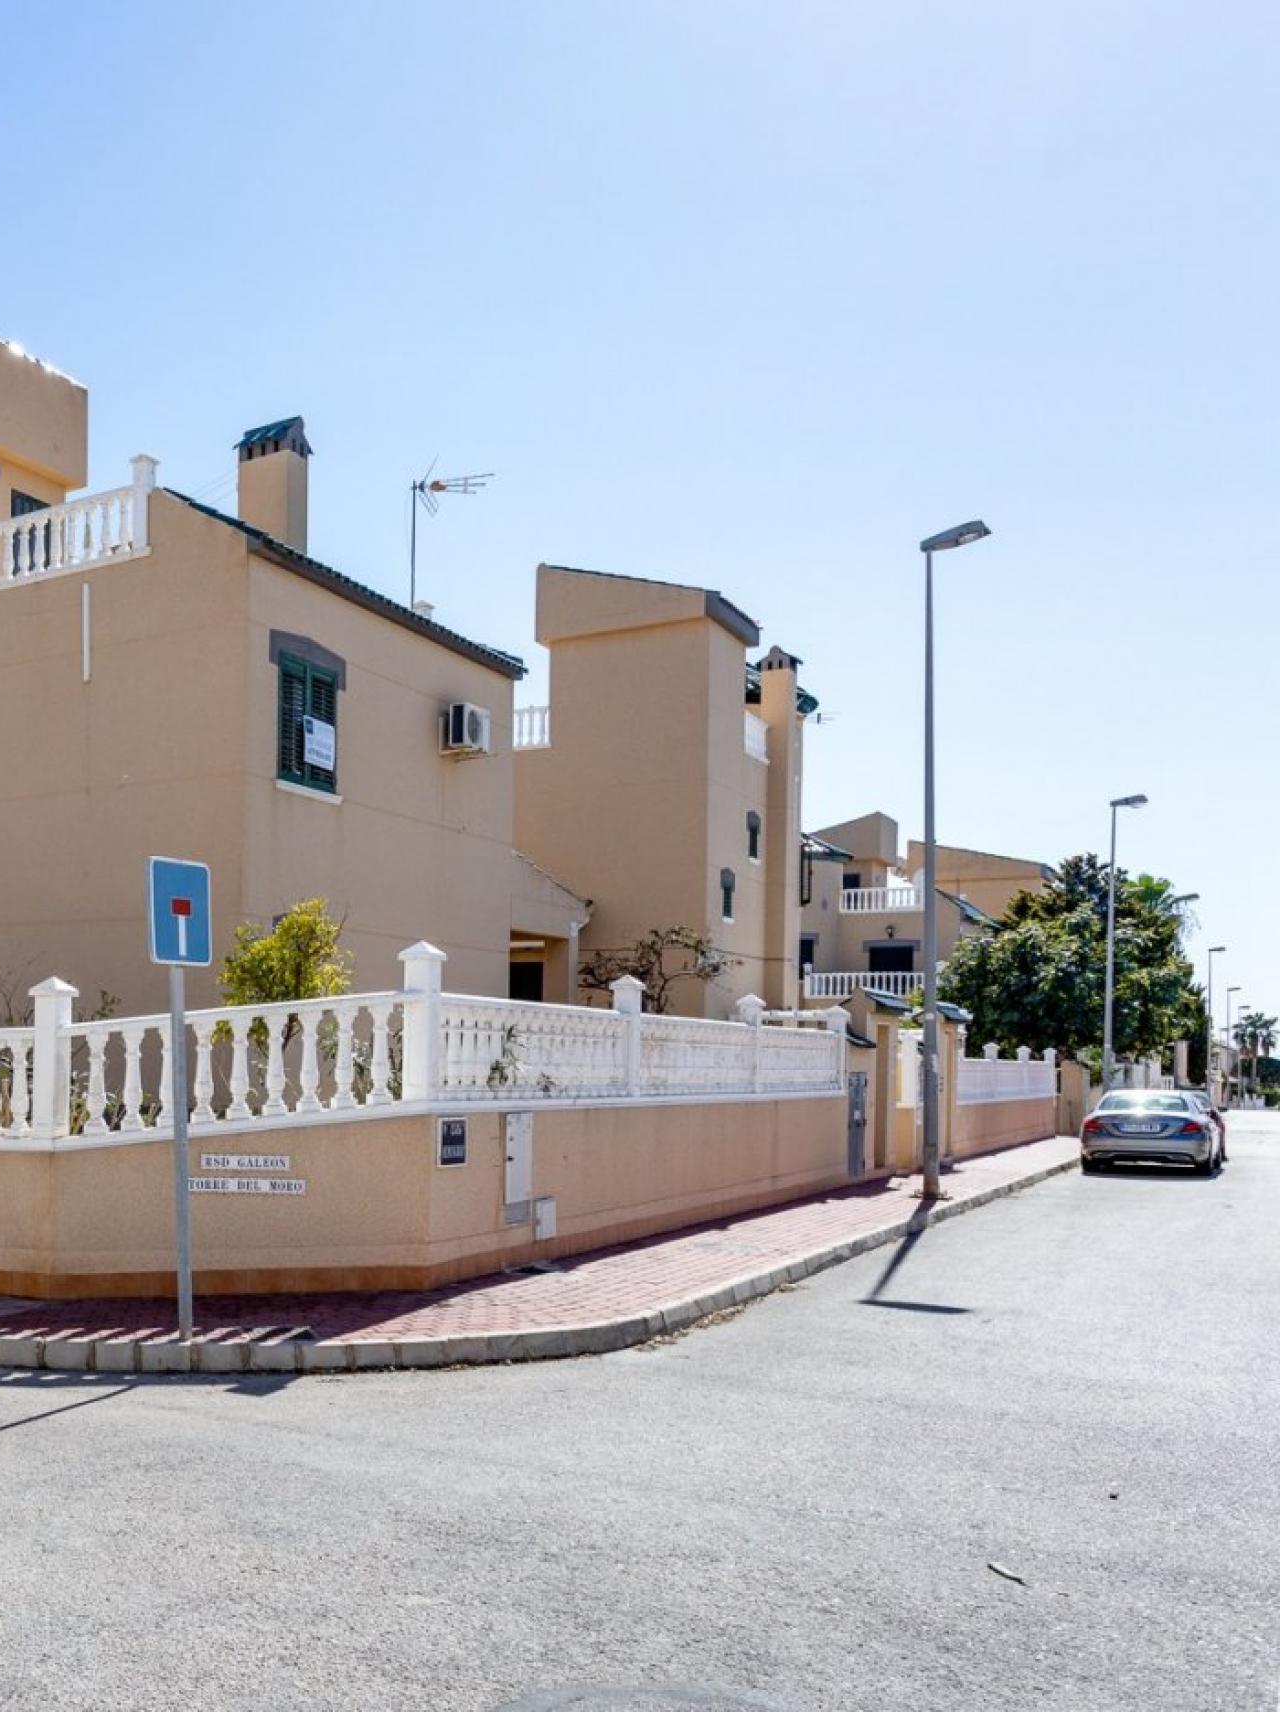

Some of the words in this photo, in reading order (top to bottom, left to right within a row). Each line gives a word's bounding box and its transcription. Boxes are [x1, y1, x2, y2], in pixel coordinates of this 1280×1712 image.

[237, 1157, 286, 1168] GALEON
[237, 1180, 261, 1191] DEL
[269, 1181, 303, 1192] MORO
